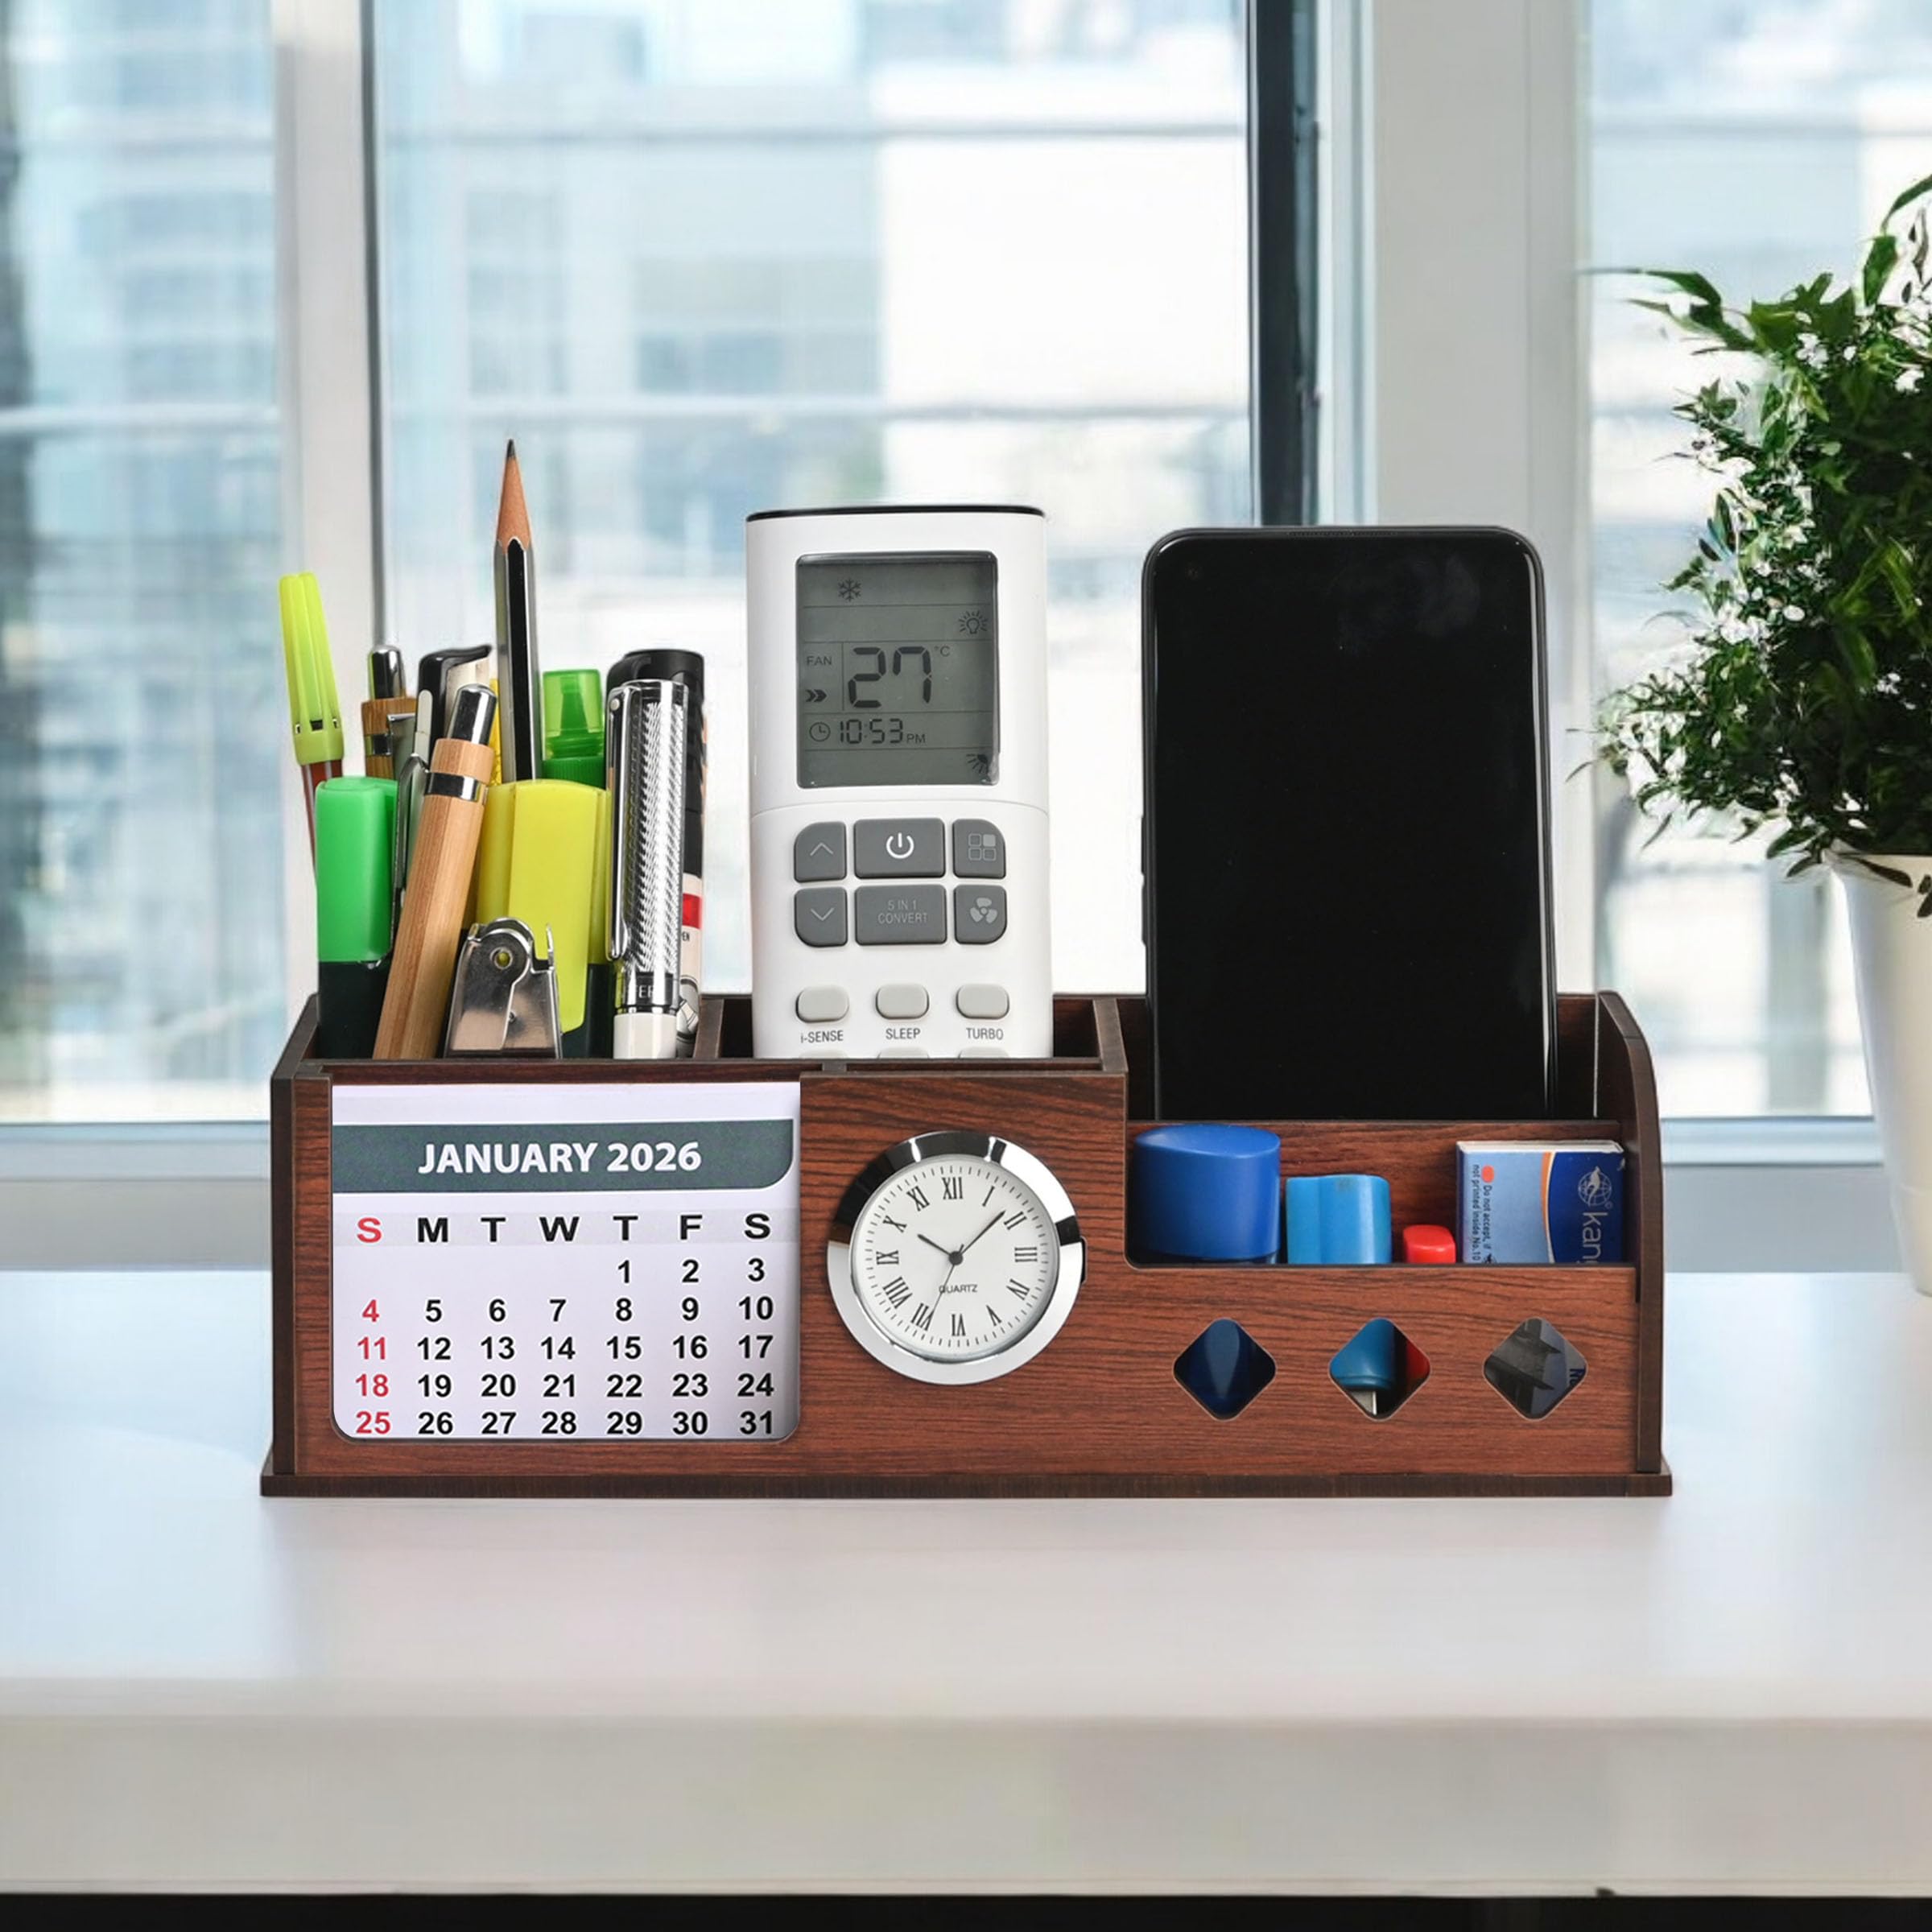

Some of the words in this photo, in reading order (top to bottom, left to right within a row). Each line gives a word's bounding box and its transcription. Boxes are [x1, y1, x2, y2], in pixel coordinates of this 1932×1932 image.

[807, 655, 832, 667] FAN
[847, 646, 932, 708] 27
[839, 717, 904, 745] 10:53
[906, 733, 926, 744] PM
[888, 899, 895, 911] 5
[898, 899, 908, 910] IN
[877, 912, 927, 924] CONVERT
[800, 1030, 844, 1043] i-SENSE
[886, 1027, 921, 1040] SLEEP
[966, 1027, 1004, 1040] TURBO
[418, 1142, 599, 1174] JANUARY
[606, 1141, 702, 1172] 2026
[1472, 1164, 1480, 1178] not
[906, 1186, 931, 1212] XI
[942, 1176, 964, 1200] XII
[981, 1185, 995, 1208] I
[1471, 1179, 1480, 1209] printed
[1483, 1184, 1492, 1197] Do
[1483, 1198, 1492, 1212] not
[357, 1217, 382, 1243] S
[418, 1217, 448, 1243] M
[481, 1217, 506, 1242] T
[539, 1216, 580, 1242] W
[613, 1216, 638, 1241] T
[680, 1214, 703, 1241] F
[744, 1213, 770, 1240] S
[881, 1215, 907, 1233] X
[1002, 1211, 1027, 1231] II
[1472, 1210, 1481, 1235] inside
[1581, 1212, 1608, 1263] kan
[875, 1249, 900, 1265] IX
[1013, 1246, 1038, 1263] III
[617, 1260, 630, 1284] 1
[682, 1259, 699, 1283] 2
[748, 1257, 765, 1282] 3
[881, 1276, 914, 1310] VIII
[938, 1283, 978, 1294] QUARTZ
[362, 1299, 380, 1323] 4
[426, 1299, 442, 1323] 5
[489, 1298, 506, 1323] 6
[550, 1298, 567, 1322] 7
[616, 1298, 632, 1322] 8
[682, 1297, 699, 1321] 9
[738, 1296, 774, 1320] 10
[985, 1304, 1003, 1327] V
[357, 1336, 386, 1360] 11
[417, 1337, 452, 1360] 12
[481, 1336, 515, 1360] 13
[541, 1336, 576, 1360] 14
[606, 1335, 642, 1360] 15
[672, 1335, 708, 1359] 16
[738, 1335, 774, 1359] 17
[355, 1373, 389, 1397] 18
[418, 1374, 452, 1397] 19
[481, 1373, 516, 1397] 20
[543, 1373, 575, 1397] 21
[606, 1373, 642, 1397] 22
[672, 1373, 708, 1397] 23
[737, 1373, 774, 1397] 24
[356, 1412, 390, 1435] 25
[418, 1411, 453, 1435] 26
[481, 1411, 517, 1435] 27
[542, 1411, 577, 1435] 28
[607, 1411, 642, 1435] 29
[672, 1411, 708, 1435] 30
[740, 1410, 772, 1435] 31
